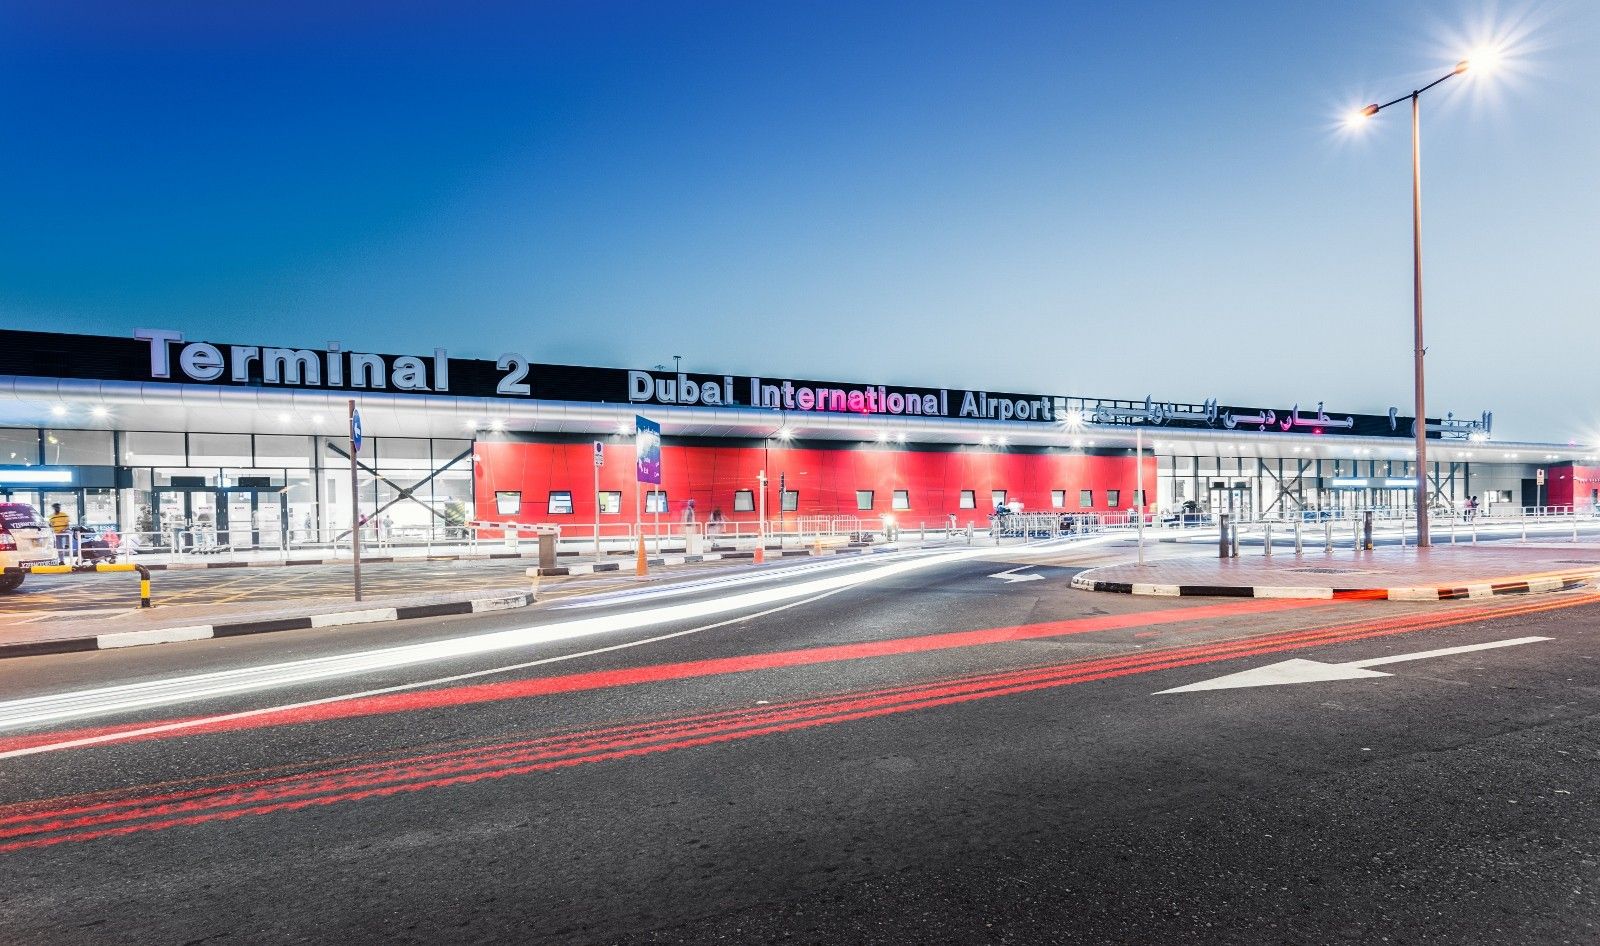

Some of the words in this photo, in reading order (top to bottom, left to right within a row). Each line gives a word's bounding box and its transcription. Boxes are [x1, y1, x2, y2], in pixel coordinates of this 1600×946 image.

[133, 327, 449, 392] Terminal
[496, 352, 531, 396] 2
[628, 370, 734, 406] Dubai
[750, 377, 948, 416] International
[959, 391, 1051, 421] Airport
[1280, 402, 1354, 432] مطار
